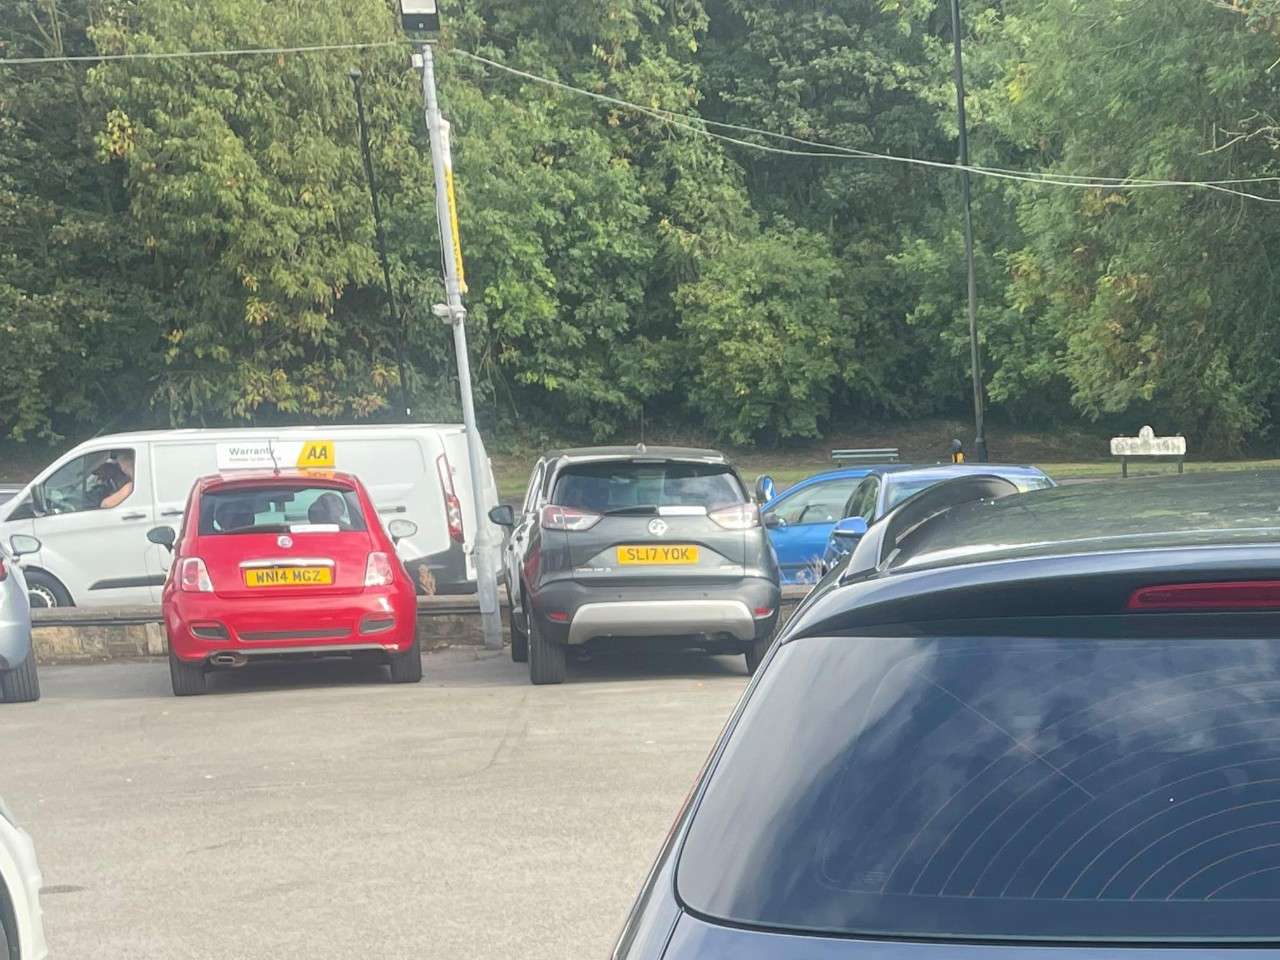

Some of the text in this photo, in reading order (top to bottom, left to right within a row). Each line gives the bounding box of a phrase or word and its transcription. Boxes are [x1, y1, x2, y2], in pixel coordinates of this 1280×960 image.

[229, 446, 275, 457] Warranty
[307, 445, 328, 460] AA
[626, 547, 690, 561] SL17 YOK
[256, 569, 321, 584] WN14 MGZ
